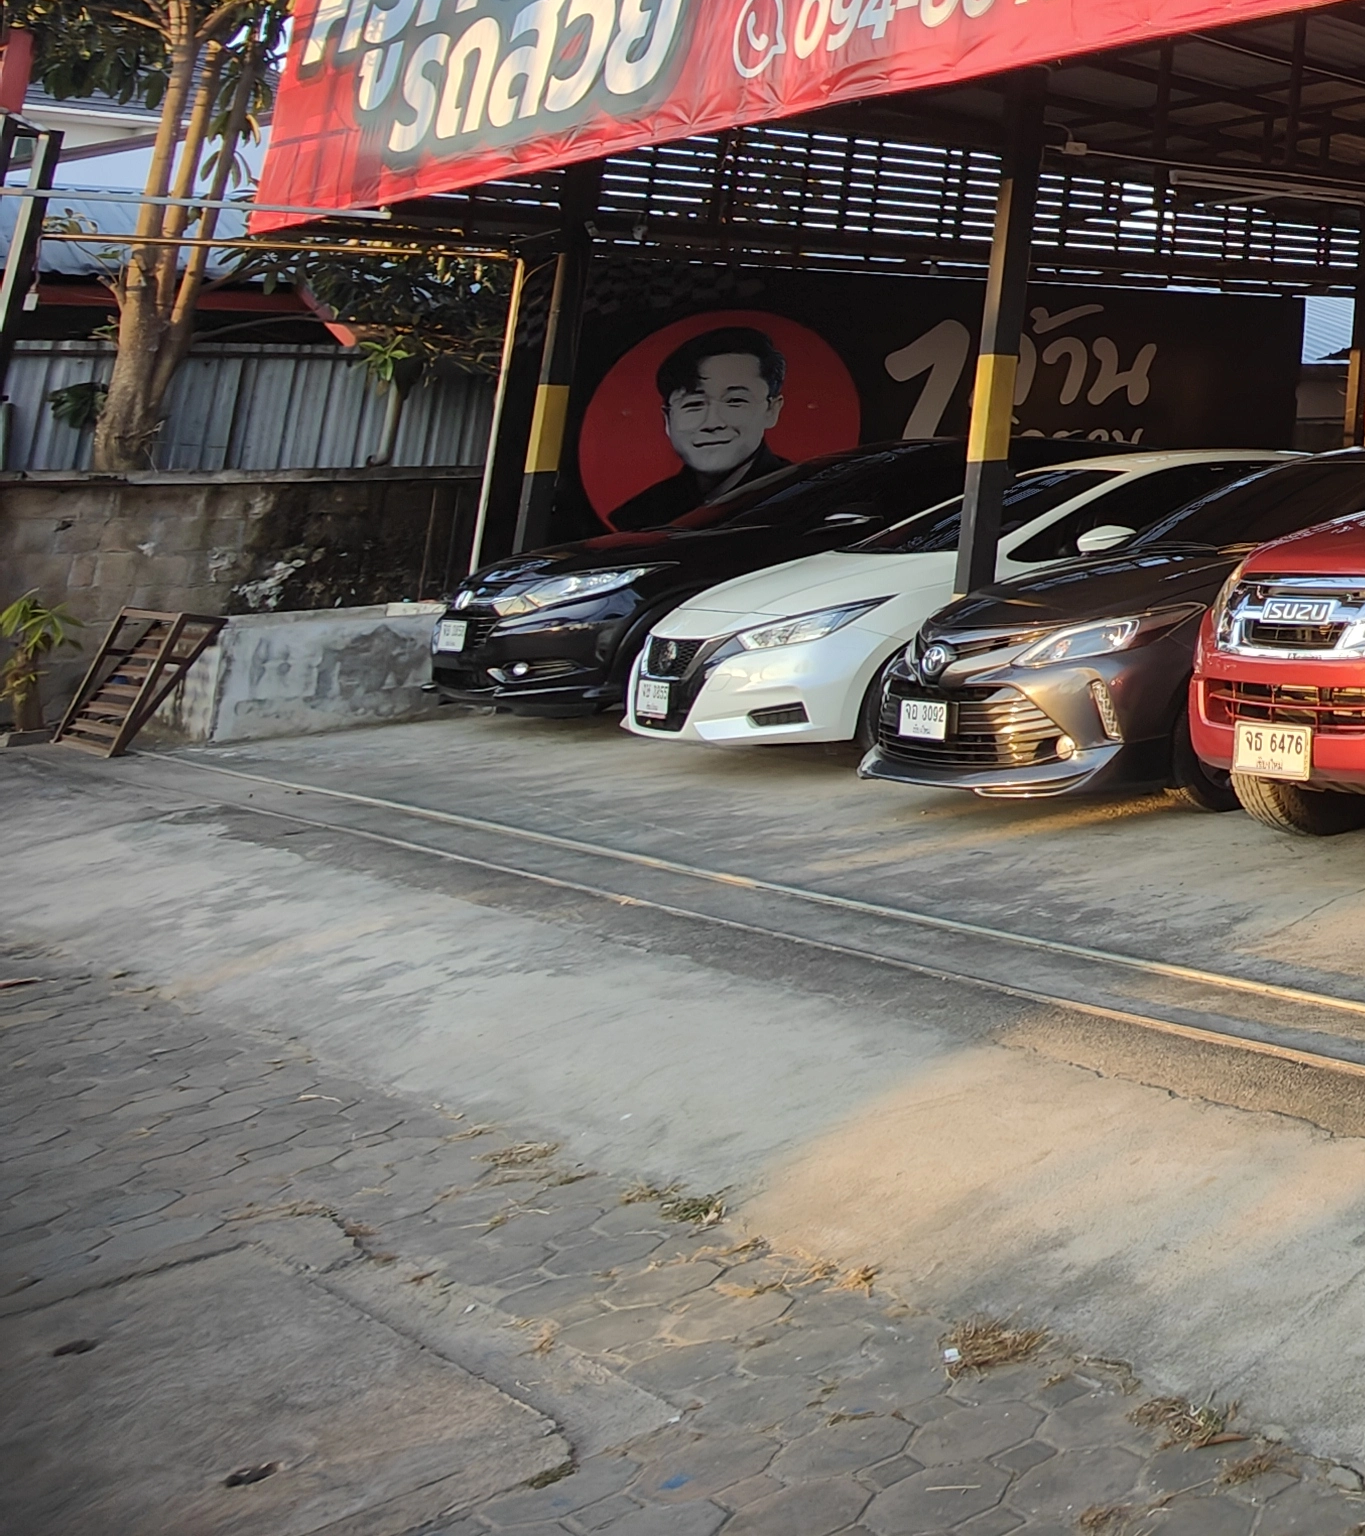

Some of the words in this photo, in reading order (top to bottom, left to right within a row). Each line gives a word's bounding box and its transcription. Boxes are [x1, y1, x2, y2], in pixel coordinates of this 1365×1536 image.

[1263, 602, 1329, 621] ISUZU
[922, 704, 944, 723] 3092
[1270, 733, 1303, 755] 6476
